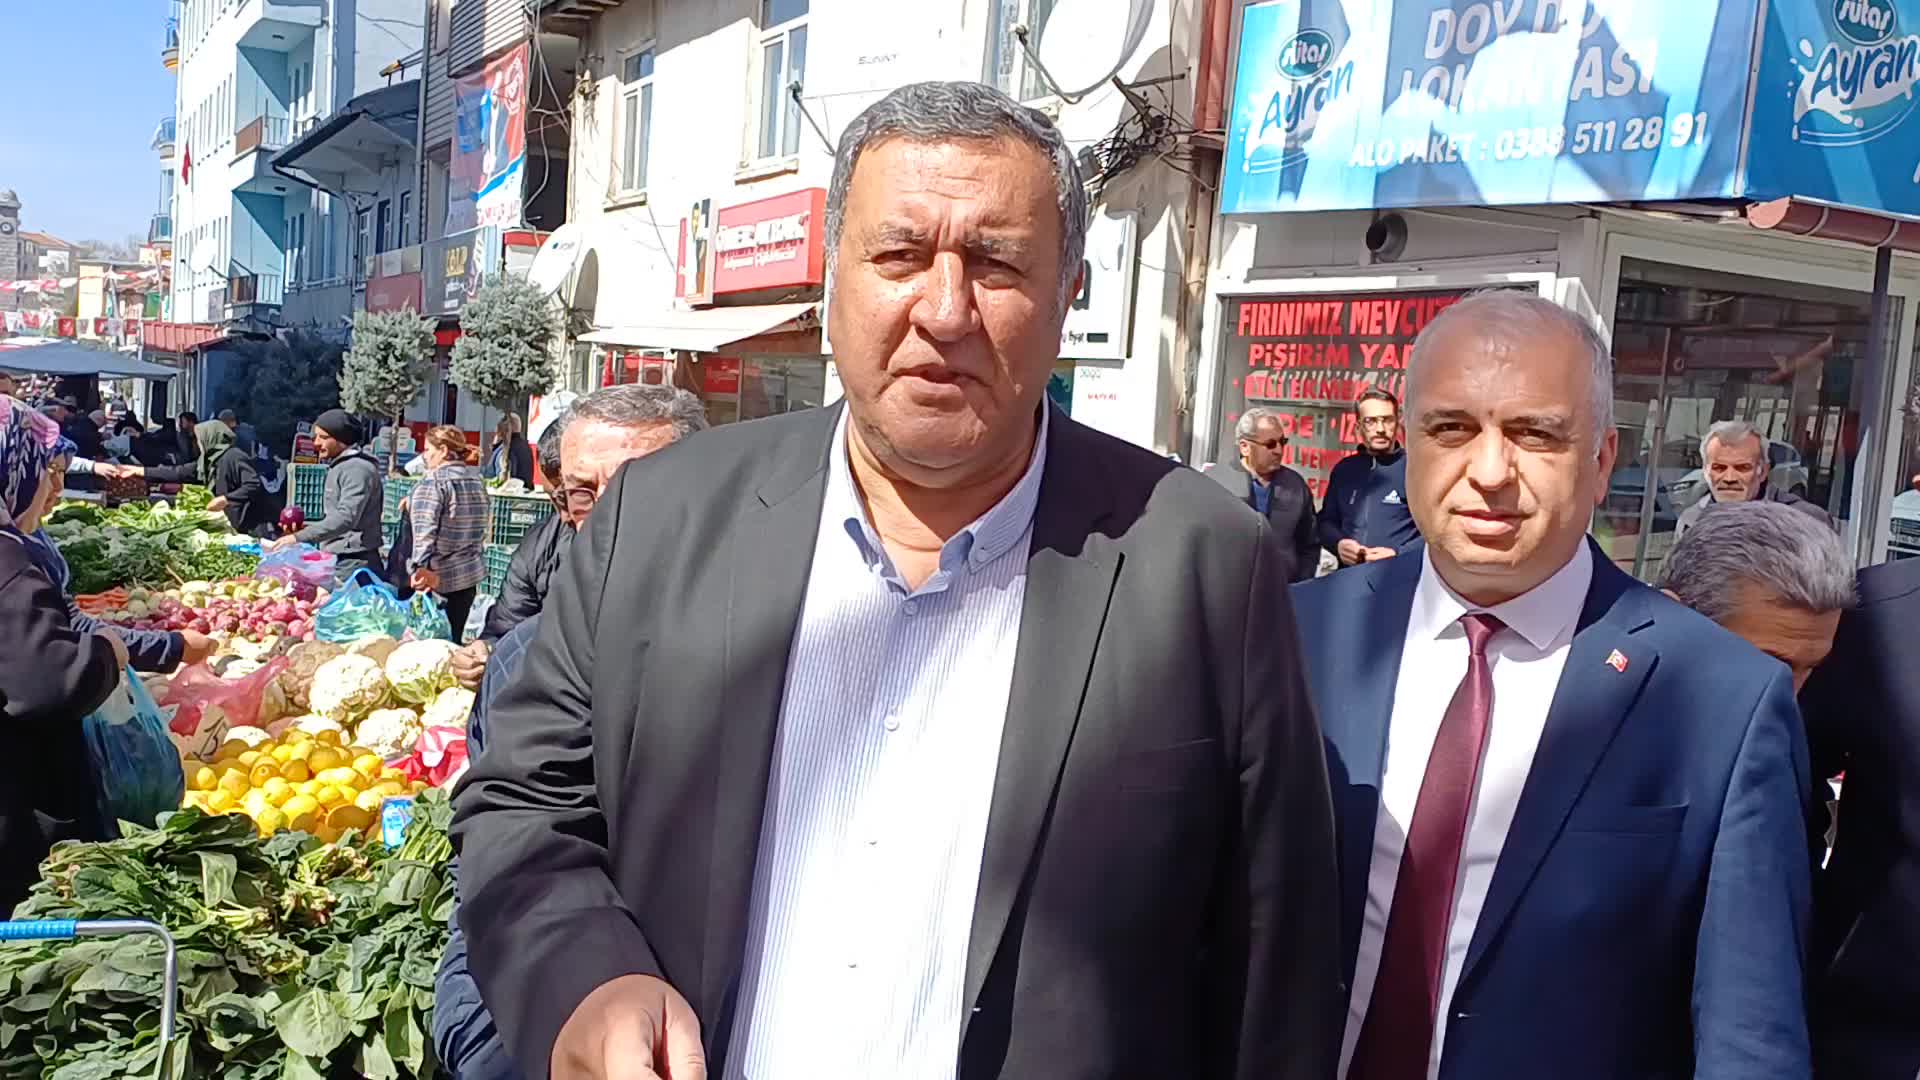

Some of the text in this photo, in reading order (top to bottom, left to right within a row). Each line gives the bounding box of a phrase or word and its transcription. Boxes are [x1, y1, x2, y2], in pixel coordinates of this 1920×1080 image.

[1259, 59, 1355, 139] Ayran
[1811, 38, 1917, 105] Ayran
[1399, 132, 1477, 166] PAKET
[1572, 120, 1616, 154] 511
[1622, 115, 1664, 151] 28
[1670, 111, 1708, 149] 91
[1238, 301, 1344, 337] FIRINIMIZ
